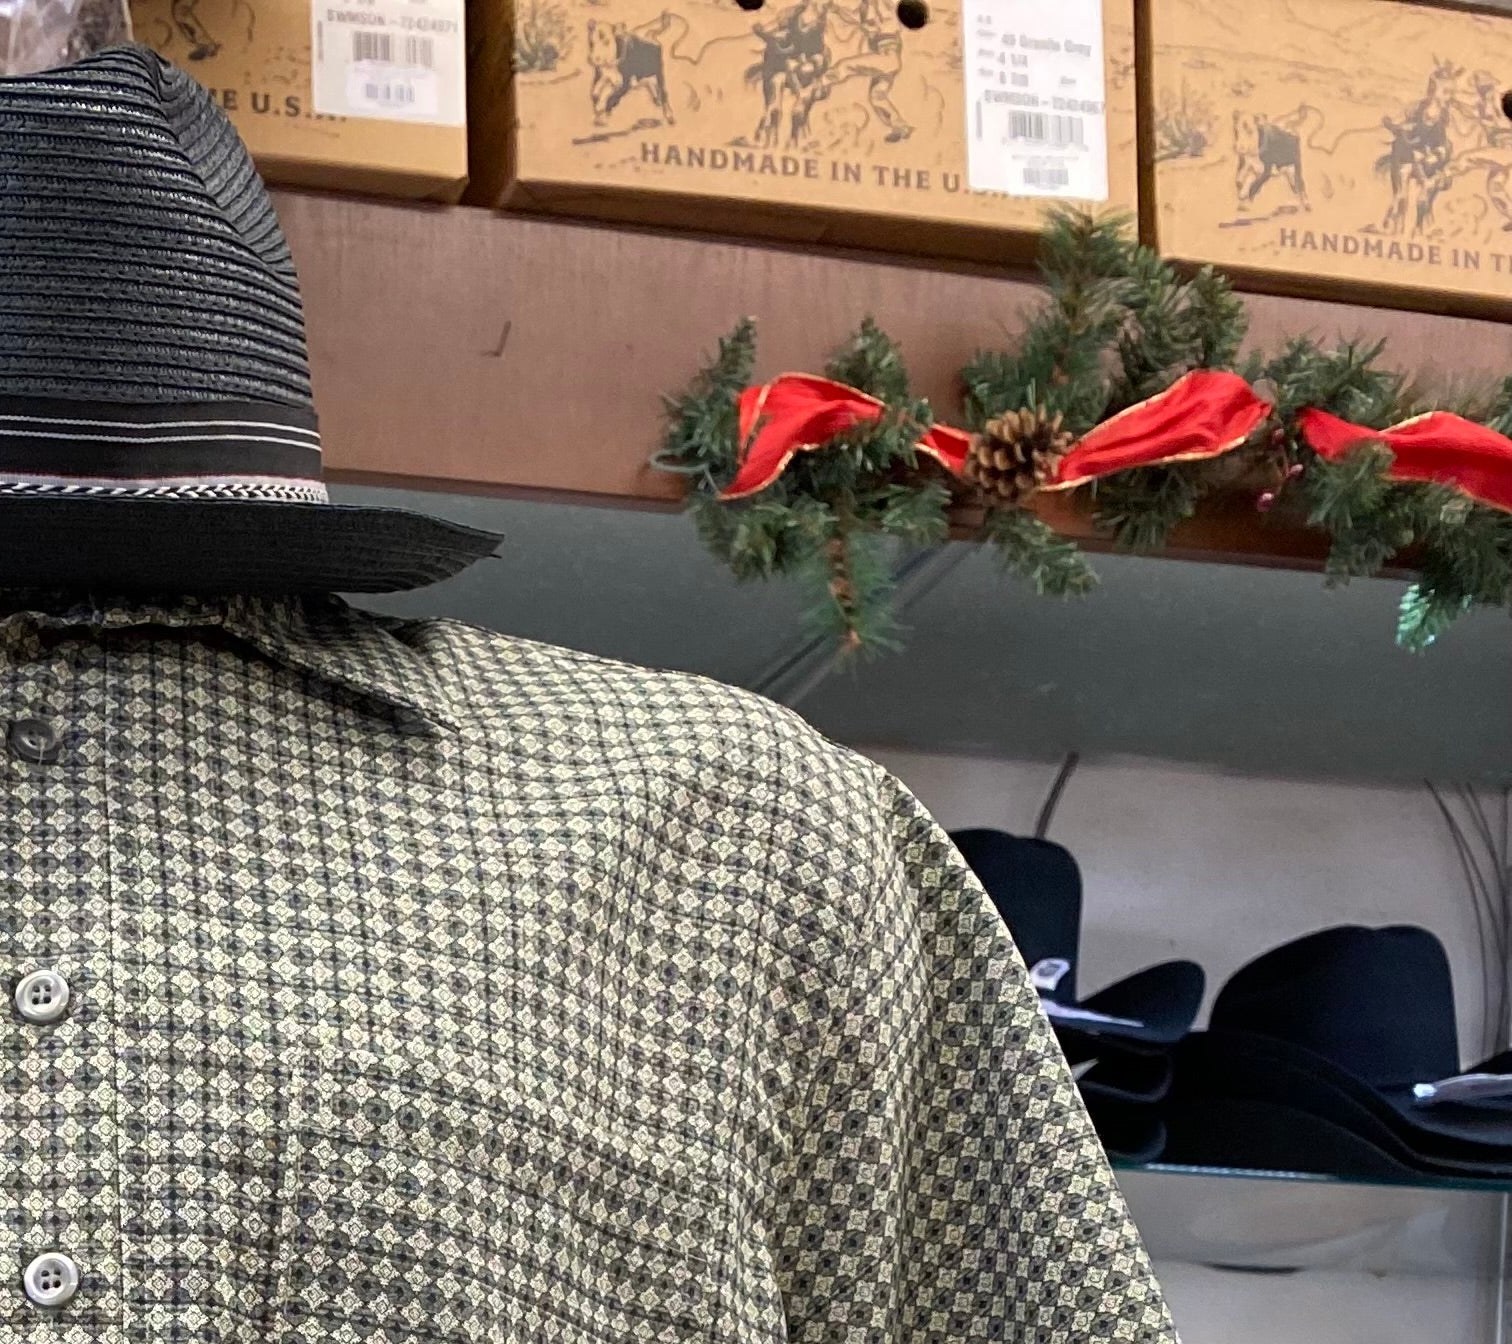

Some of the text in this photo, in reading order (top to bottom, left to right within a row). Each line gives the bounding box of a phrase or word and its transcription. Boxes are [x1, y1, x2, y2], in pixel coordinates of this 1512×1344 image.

[251, 92, 347, 122] U.S..
[640, 141, 818, 180] HANDMADE
[831, 161, 862, 184] IN
[872, 165, 931, 190] THE
[1279, 227, 1512, 274] HANDMADE IN T
